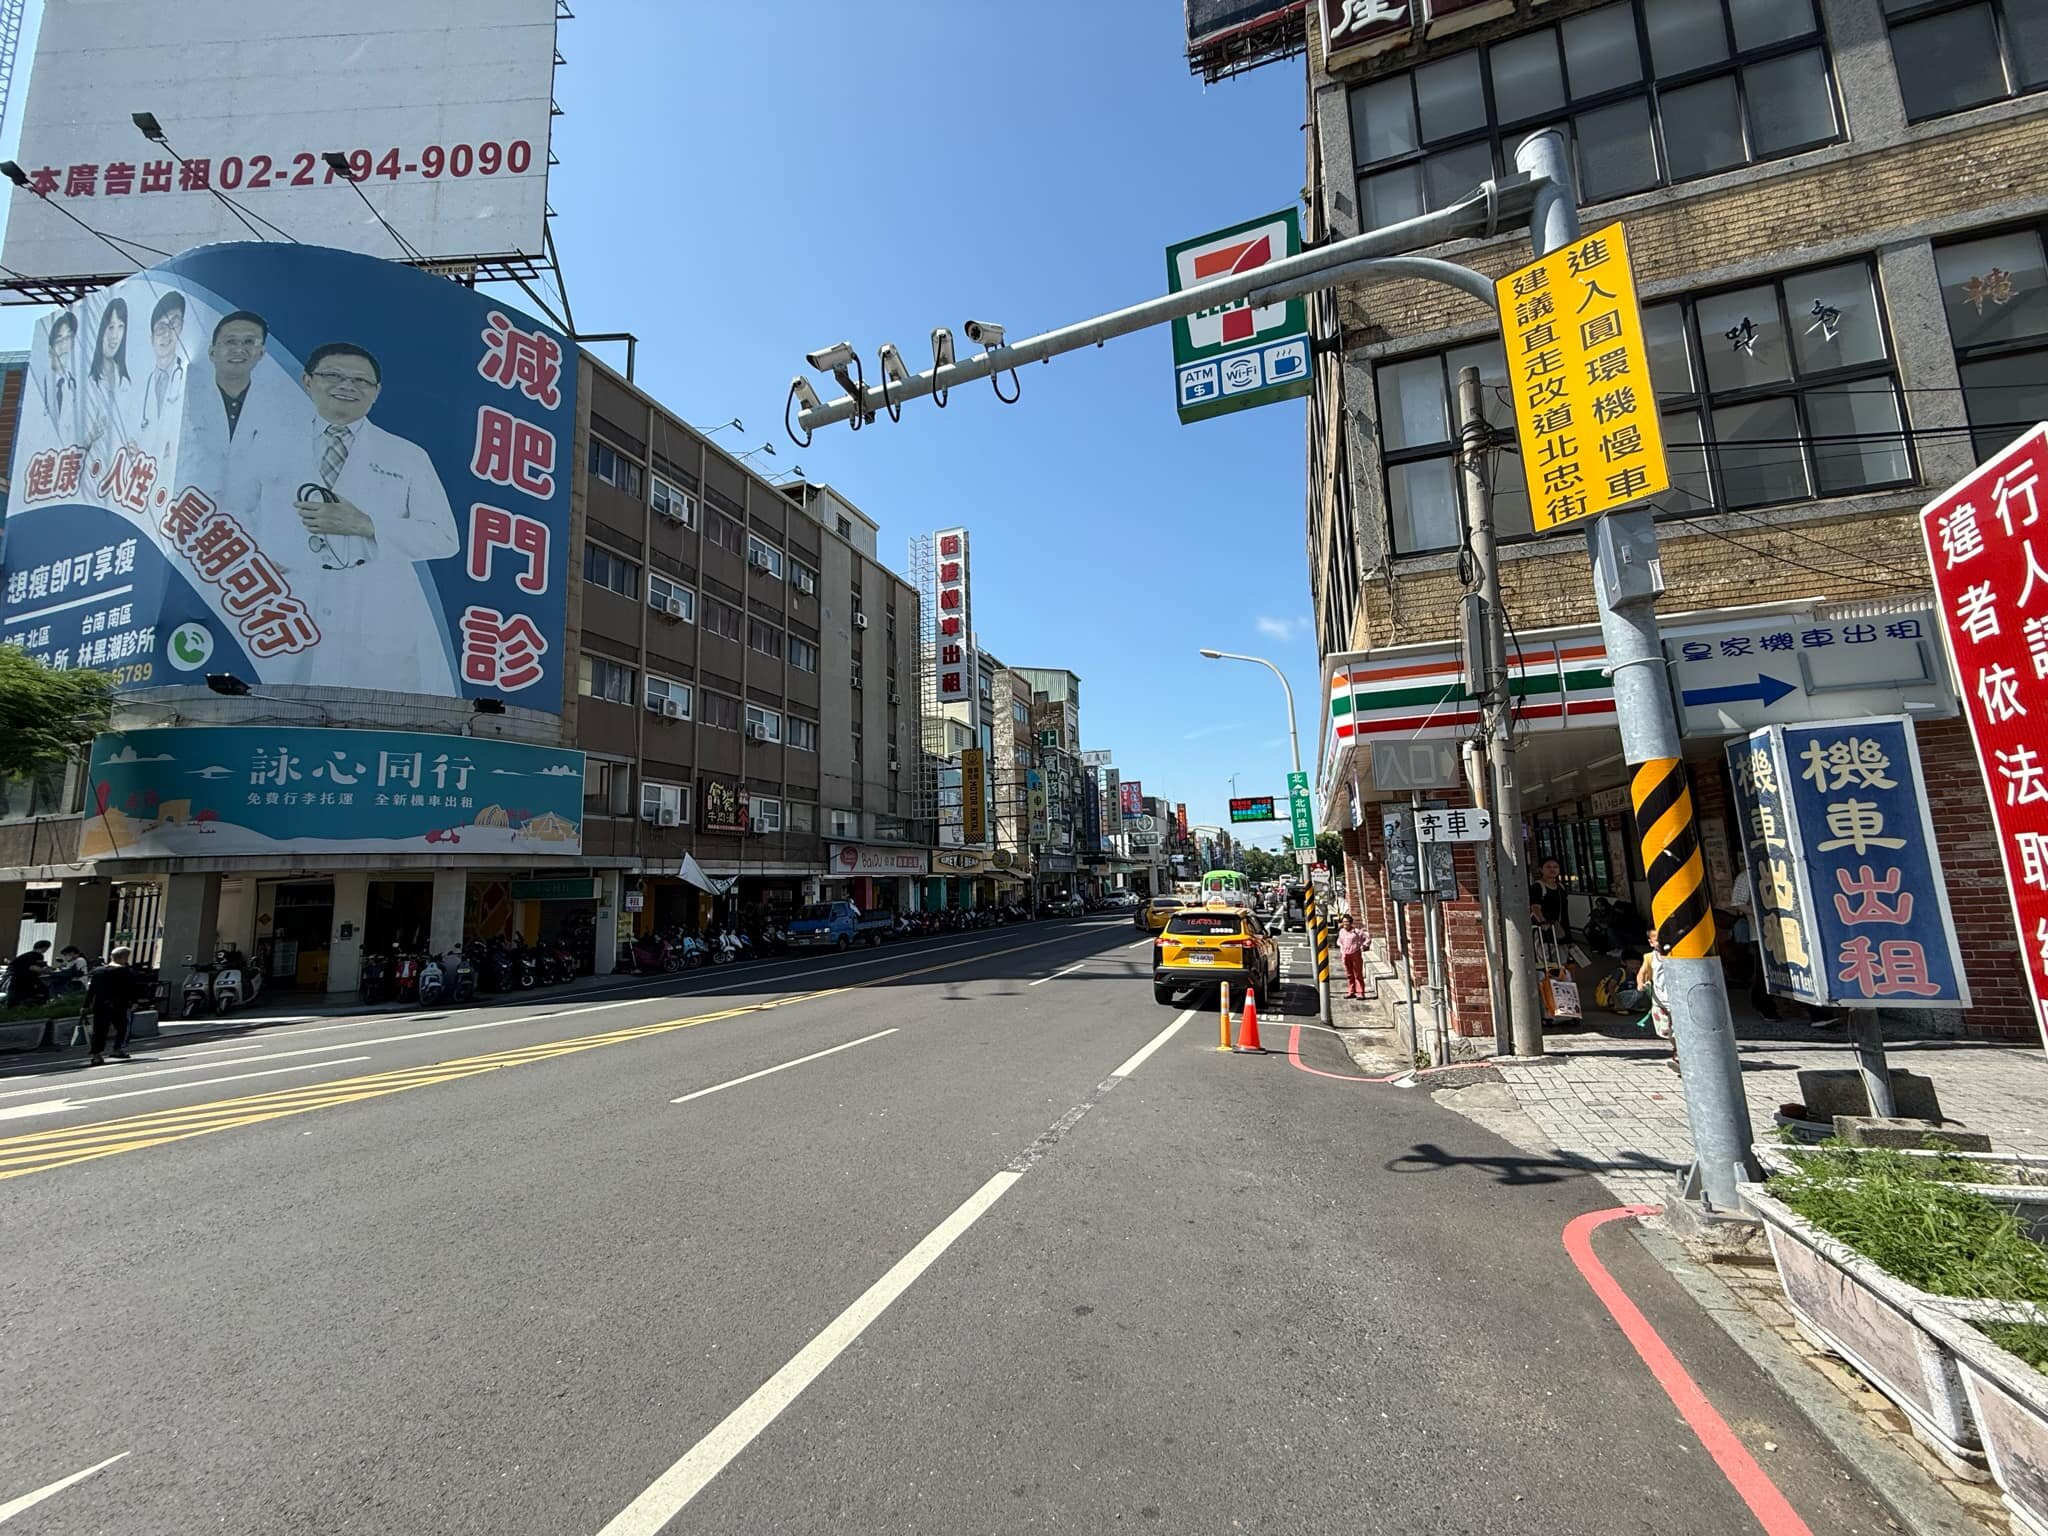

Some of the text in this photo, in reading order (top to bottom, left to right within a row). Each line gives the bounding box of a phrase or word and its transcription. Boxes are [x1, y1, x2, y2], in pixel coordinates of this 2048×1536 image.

[1185, 366, 1257, 383] ATM Wi-Fi
[1566, 238, 1650, 500] 進入圓環機慢車
[1512, 266, 1589, 524] 建議直走改道北忠街
[461, 311, 562, 691] 減肥門診
[77, 626, 156, 668] 林黑潮診所
[1682, 619, 1923, 662] 皇家機車出租
[248, 746, 476, 790] 詠心同行
[1292, 774, 1303, 783] 北
[247, 792, 474, 808] 免費行李托運 全新機車出租
[1295, 799, 1310, 847] 北門路二段
[1419, 810, 1469, 841] 寄車
[1736, 748, 1809, 968] 機車出租
[1800, 737, 1942, 998] 機車出租
